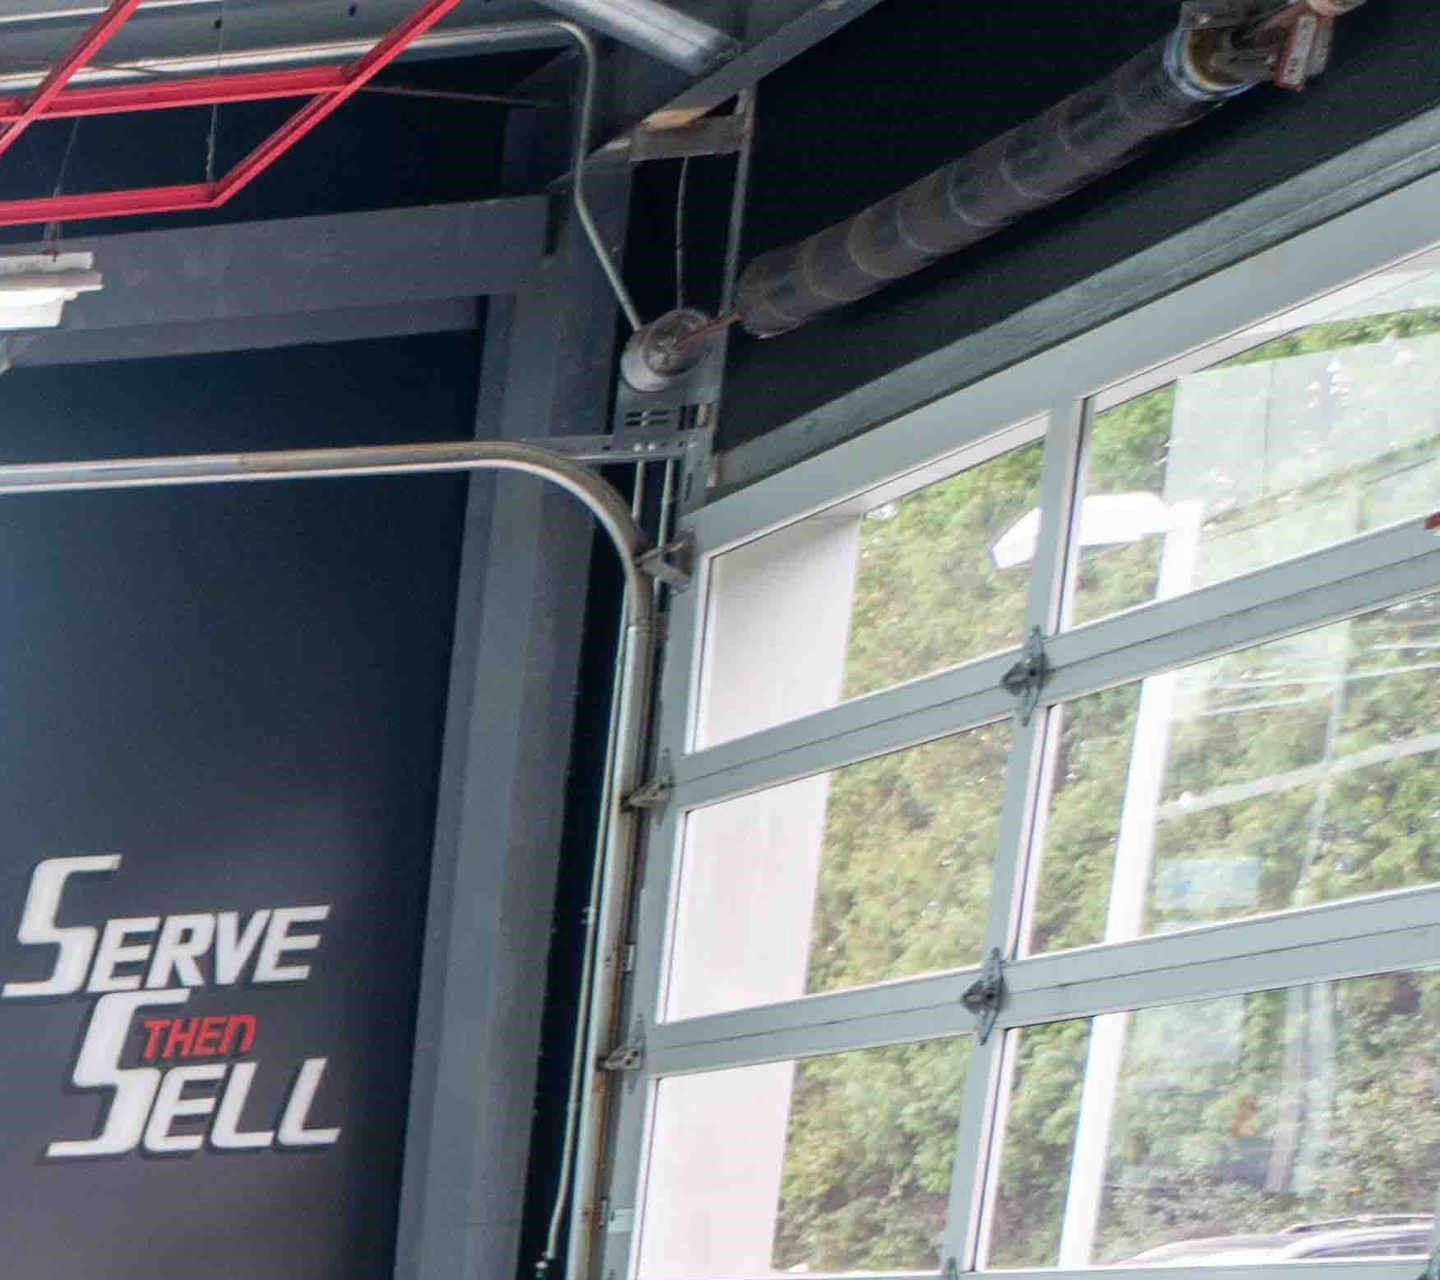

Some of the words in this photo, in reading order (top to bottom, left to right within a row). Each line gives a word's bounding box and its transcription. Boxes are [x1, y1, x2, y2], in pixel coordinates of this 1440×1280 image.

[1, 854, 331, 998] SERVE
[47, 988, 342, 1158] SELL
[143, 1013, 257, 1060] THEN
